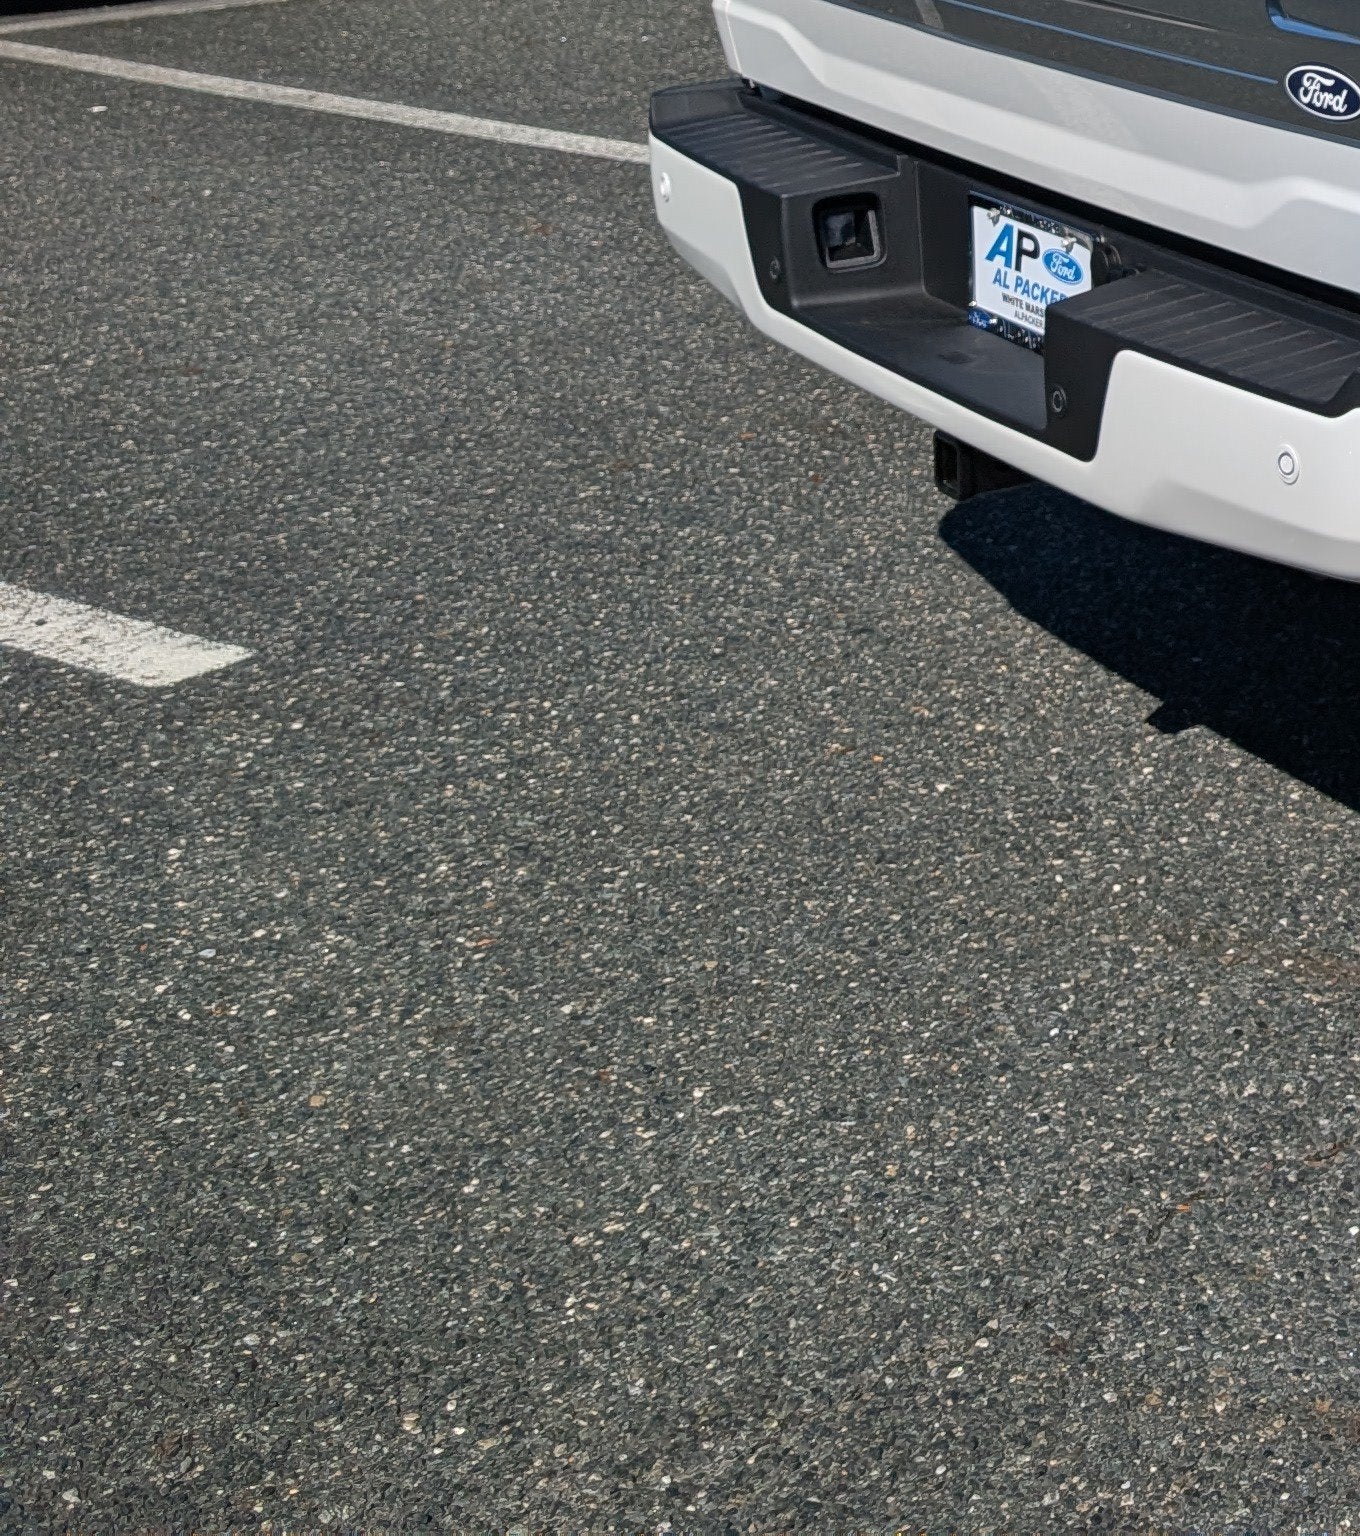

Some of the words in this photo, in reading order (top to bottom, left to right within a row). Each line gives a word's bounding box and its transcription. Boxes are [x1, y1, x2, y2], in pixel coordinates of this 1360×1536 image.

[984, 222, 1040, 272] AP
[992, 267, 1010, 289] AL
[1002, 292, 1024, 310] WHITE
